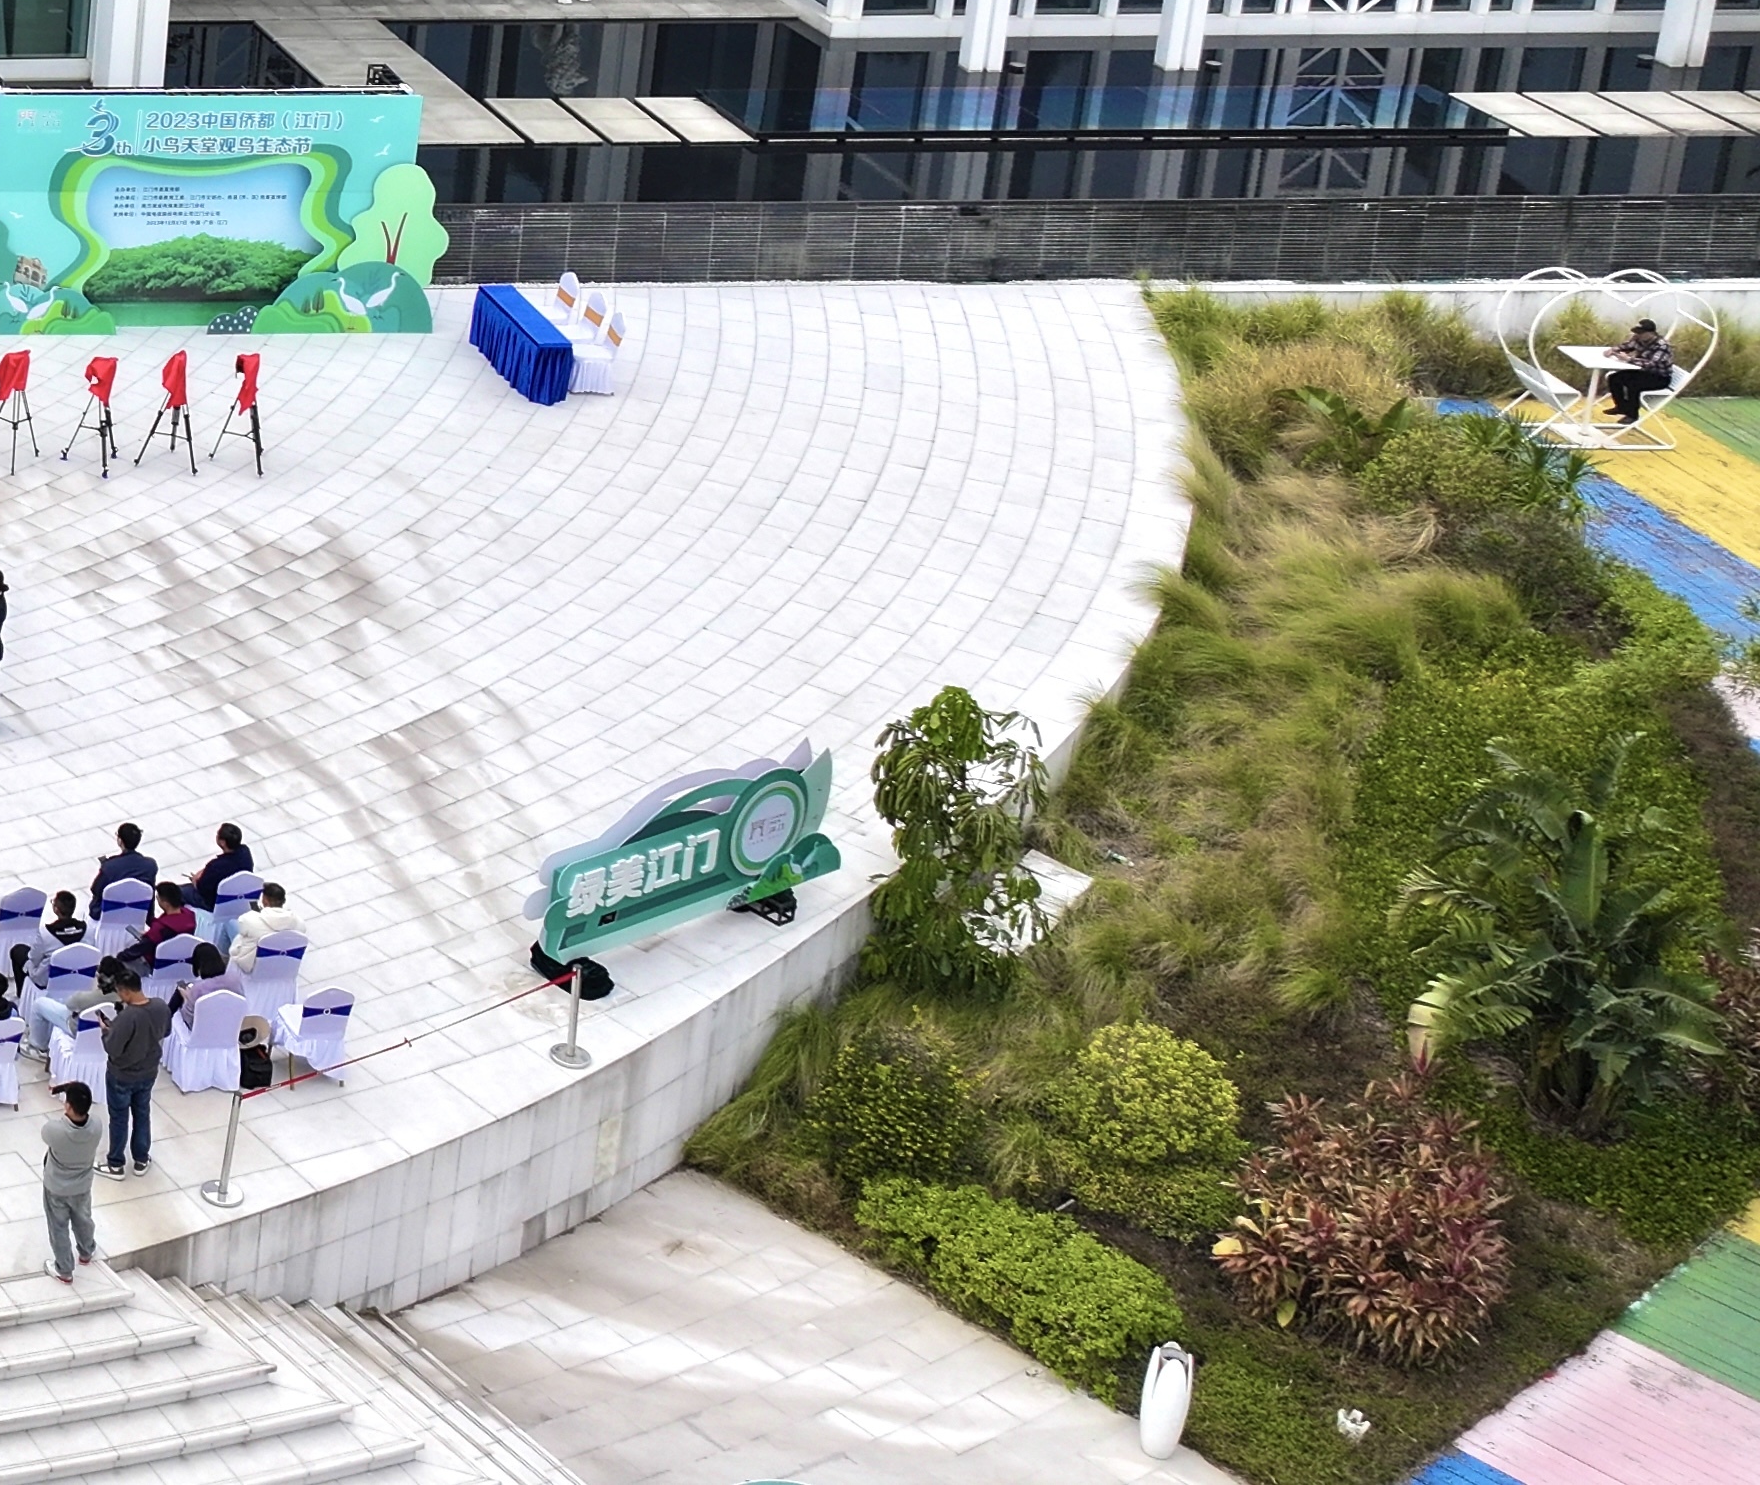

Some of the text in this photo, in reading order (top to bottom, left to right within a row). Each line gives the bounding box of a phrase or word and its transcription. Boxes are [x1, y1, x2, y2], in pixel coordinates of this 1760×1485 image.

[145, 111, 344, 130] 2023中国侨都（江门）
[143, 136, 313, 154] 小鸟天堂观鸟生态节
[565, 828, 721, 920] 绿美江门
